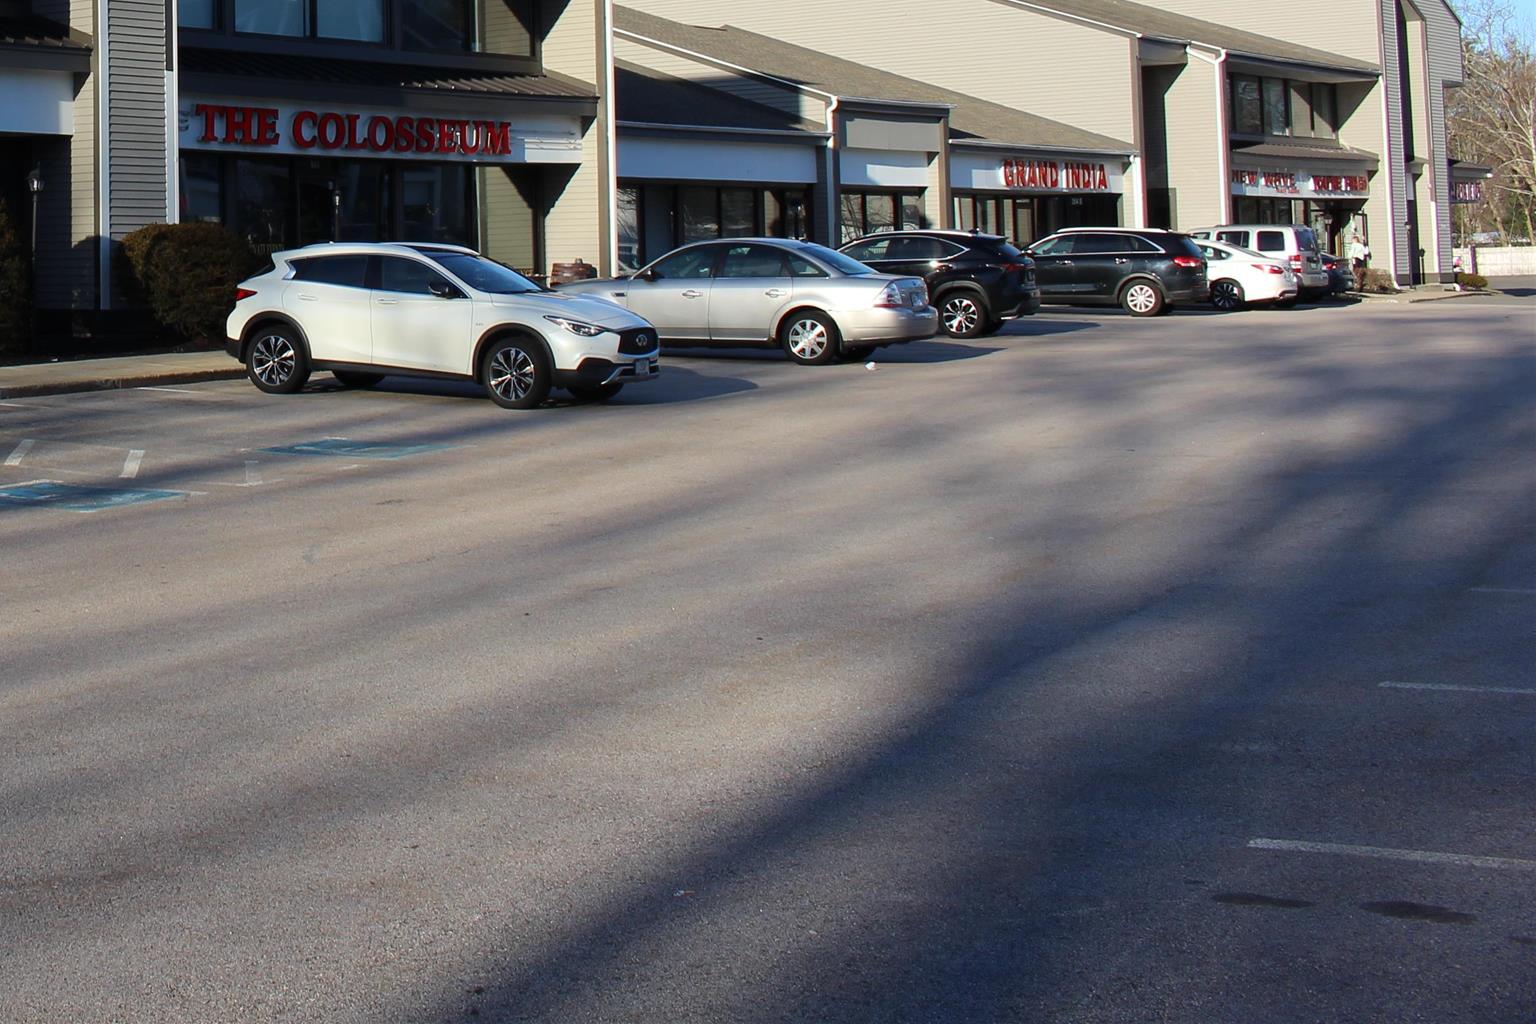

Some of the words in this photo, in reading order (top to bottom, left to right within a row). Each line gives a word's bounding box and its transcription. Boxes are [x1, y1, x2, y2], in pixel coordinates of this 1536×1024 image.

[195, 103, 280, 146] THE
[291, 110, 512, 155] COLOSSEUM
[1003, 159, 1060, 188] GRAND
[1064, 162, 1108, 190] INDIA
[1231, 169, 1258, 185] NEW
